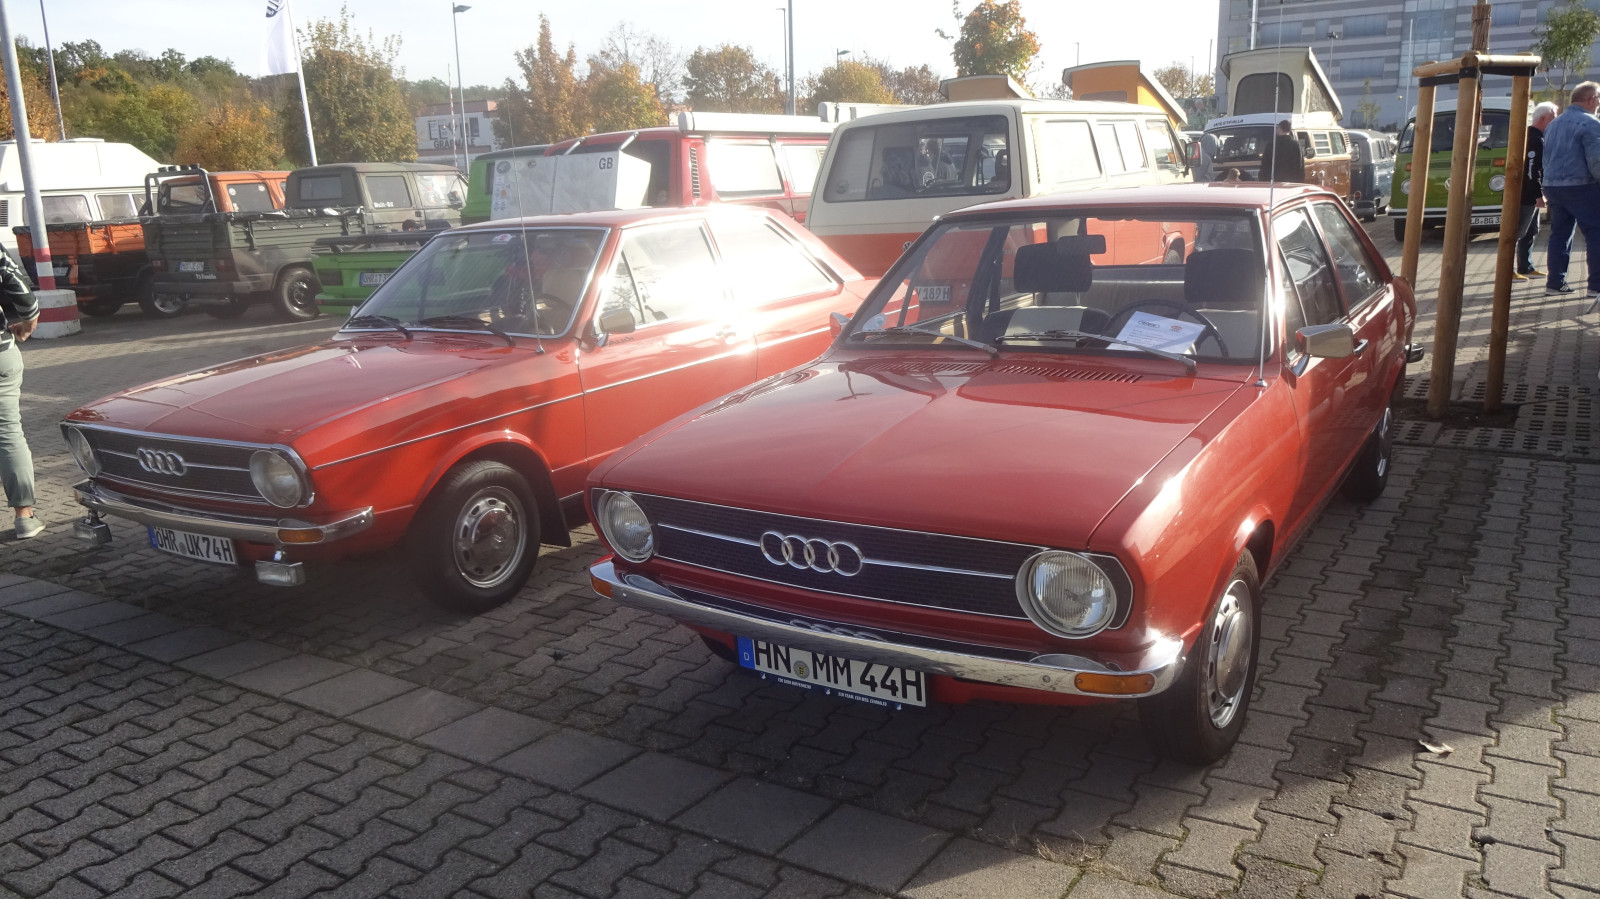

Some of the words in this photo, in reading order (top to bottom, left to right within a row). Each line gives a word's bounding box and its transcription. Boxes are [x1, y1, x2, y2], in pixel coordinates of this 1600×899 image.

[598, 157, 613, 170] GB
[153, 525, 179, 552] ÖHR
[753, 639, 792, 674] HN
[811, 652, 852, 687] MM
[859, 661, 923, 702] 44H
